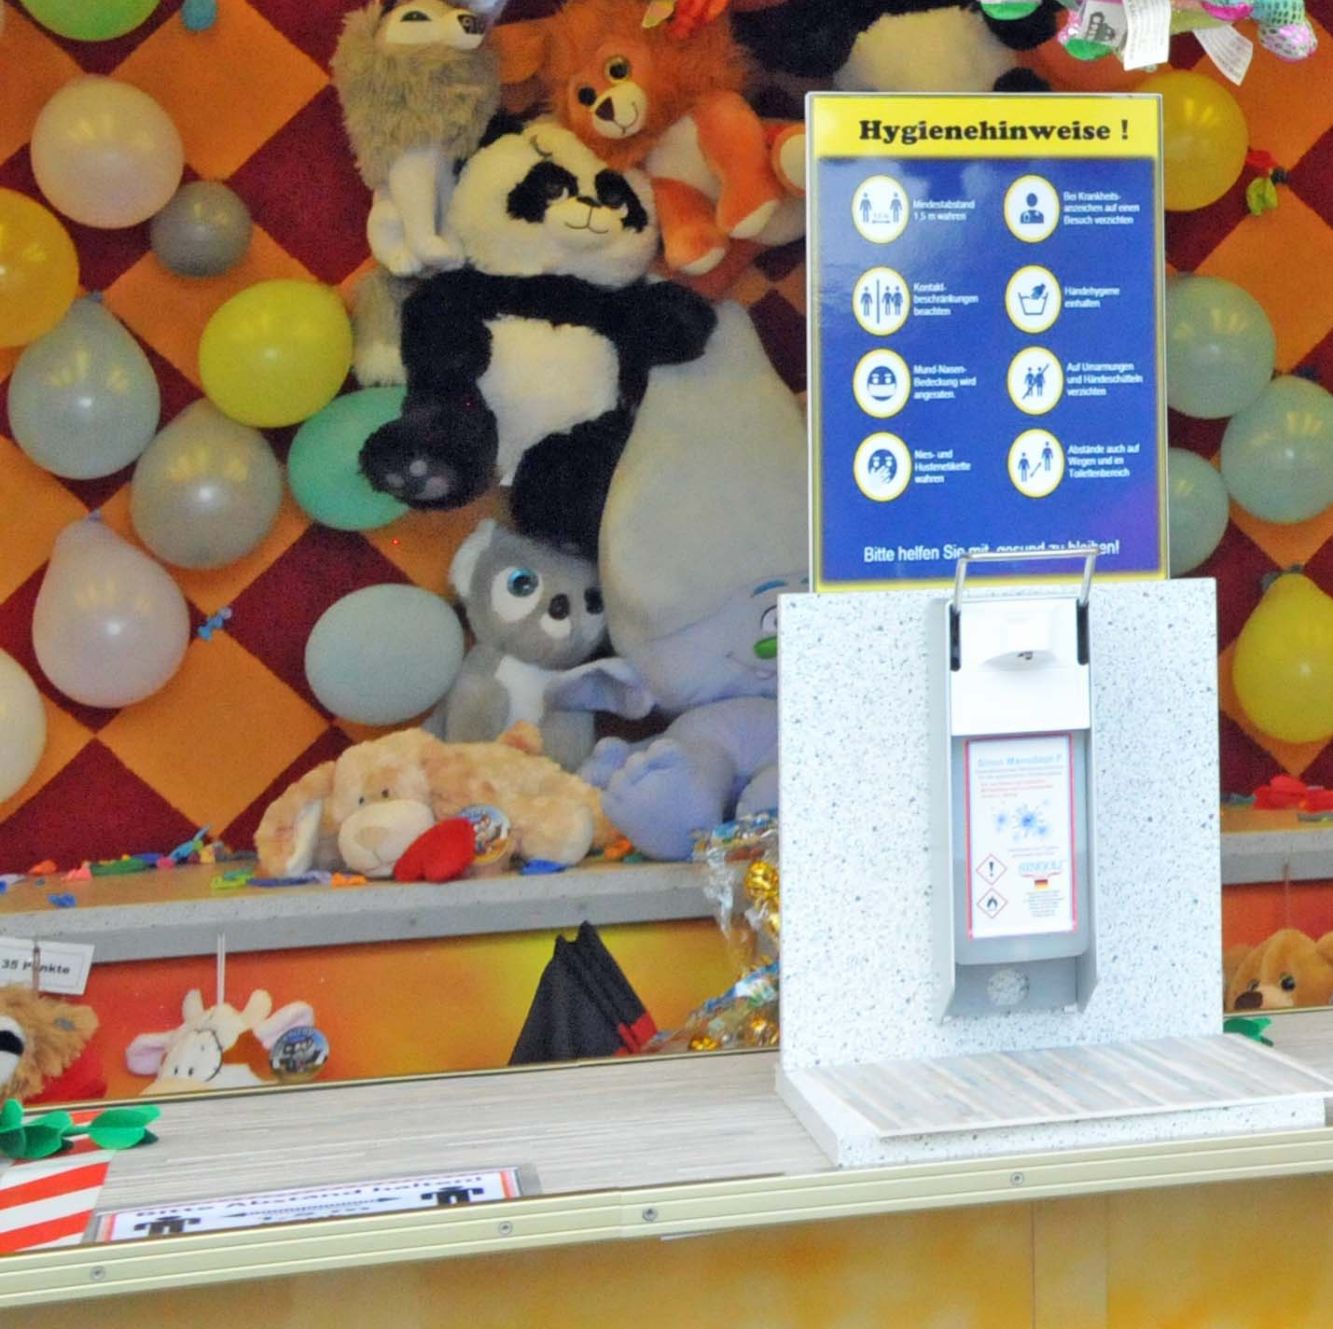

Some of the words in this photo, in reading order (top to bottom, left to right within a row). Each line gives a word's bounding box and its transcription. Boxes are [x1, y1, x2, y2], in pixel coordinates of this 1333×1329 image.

[859, 119, 1111, 145] Hygienehinweise
[912, 200, 976, 210] Mindestabstand
[1105, 203, 1117, 212] auf
[1118, 203, 1140, 212] einen
[937, 212, 967, 221] wahren
[1063, 215, 1093, 225] Besuch
[1095, 215, 1134, 224] verzichten
[1064, 286, 1120, 297] Händehygiene
[913, 294, 979, 305] beschränkungen
[1064, 298, 1101, 308] einhalten
[913, 306, 952, 316] beachten
[1066, 362, 1081, 372] Auf
[1082, 362, 1135, 373] Umarmungen
[913, 377, 958, 388] Bedeckung
[960, 376, 977, 386] wird
[1066, 375, 1082, 384] und
[1083, 374, 1143, 384] Händeschütteln
[1066, 387, 1107, 396] verzichten
[937, 449, 953, 459] und
[1067, 444, 1105, 455] Abstände
[1106, 444, 1126, 454] auch
[1127, 443, 1140, 453] auf
[1067, 457, 1096, 468] Wegen
[1097, 456, 1113, 465] und
[863, 545, 895, 563] Bitte
[897, 544, 940, 561] helfen
[23, 961, 71, 975] Pnkte
